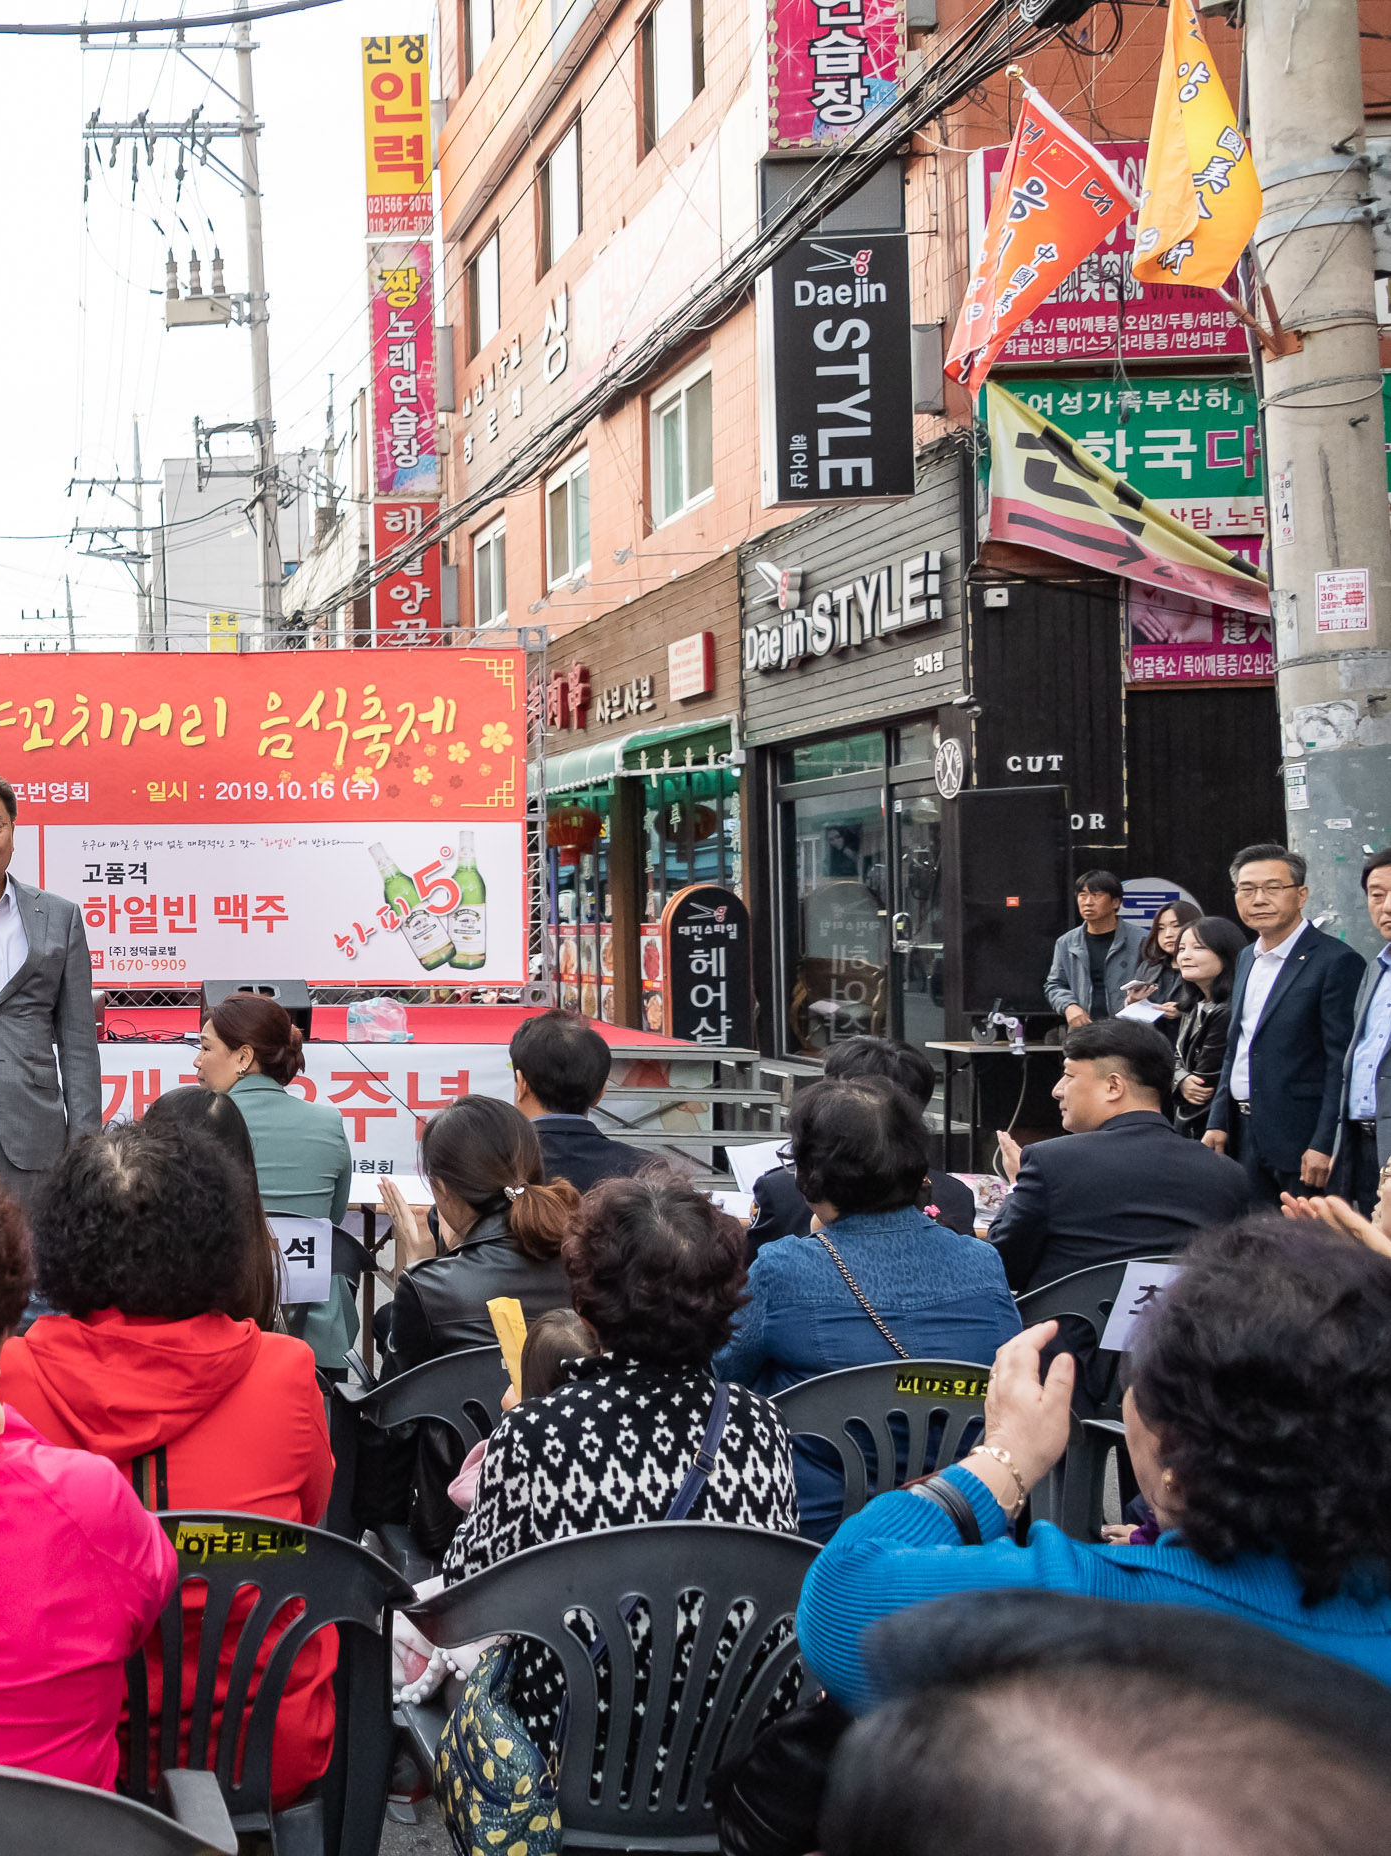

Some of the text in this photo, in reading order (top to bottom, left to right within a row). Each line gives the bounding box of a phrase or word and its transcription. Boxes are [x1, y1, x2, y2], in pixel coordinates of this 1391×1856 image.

[370, 72, 425, 184] 인력
[793, 275, 887, 308] Daejin
[812, 317, 874, 490] STYLE
[789, 434, 809, 489] 헤어샵
[745, 610, 807, 670] Daejin
[914, 650, 945, 677] 건대점
[596, 674, 655, 725] 샤브샤브
[257, 684, 458, 772] 음식축제
[1006, 754, 1064, 773] CUT
[146, 779, 380, 802] 일시 2019.10.16 (수)
[82, 839, 106, 851] 누구나
[82, 861, 149, 885] 고품격
[83, 893, 289, 934] 하얼빈 맥주
[678, 923, 738, 941] 대진스타일
[109, 959, 187, 971] 1670-9909
[129, 945, 177, 956] 정덕글로벌
[689, 947, 733, 1046] 헤어샵
